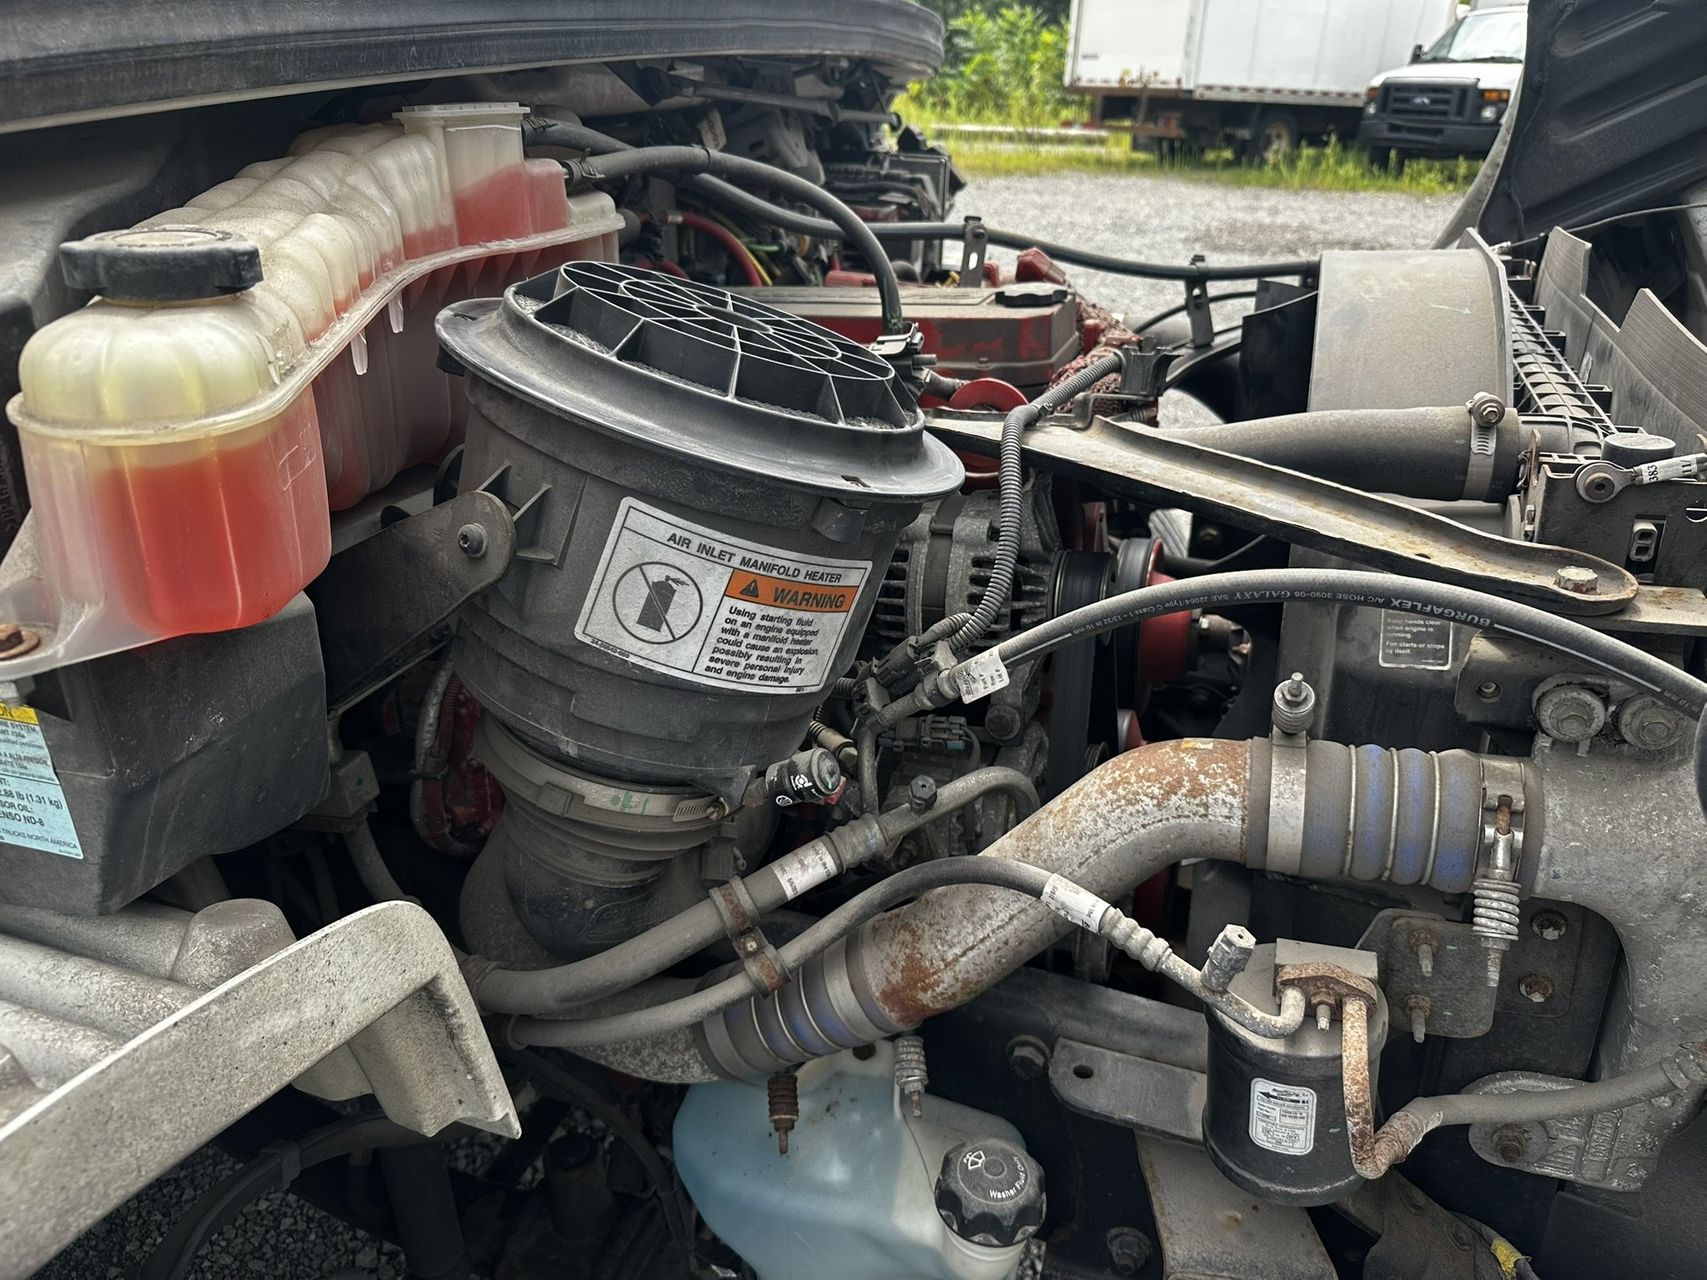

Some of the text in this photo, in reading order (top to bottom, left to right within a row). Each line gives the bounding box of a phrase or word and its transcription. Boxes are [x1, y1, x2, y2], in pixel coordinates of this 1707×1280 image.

[1647, 464, 1659, 482] 383
[666, 533, 842, 583] AIR INLET MANIFOLD HEATER
[773, 587, 846, 610] WARNING
[1164, 599, 1183, 610] Type
[1211, 593, 1229, 602] SAE
[1233, 590, 1290, 601] GALAXY
[1335, 592, 1364, 601] HOSE
[1367, 595, 1385, 604] A/C
[729, 606, 814, 626] Using starting fluid
[1134, 606, 1155, 616] Class
[1156, 604, 1163, 612] C
[1389, 597, 1491, 627] BURGAFLEX
[725, 617, 737, 625] on
[755, 624, 784, 634] engine
[786, 628, 819, 637] equipped
[1103, 613, 1122, 626] 13/32
[716, 636, 743, 648] could
[745, 643, 770, 652] cause
[721, 627, 740, 636] with
[752, 634, 789, 644] manifold
[790, 637, 813, 646] heater
[712, 646, 752, 661] possibly
[756, 654, 792, 665] resulting
[705, 665, 790, 684] and engine damage.
[708, 656, 805, 675] severe personal injury
[15, 790, 24, 800] lb
[26, 793, 46, 805] (1.31
[48, 796, 63, 810] kg)
[18, 804, 32, 813] OIL:
[0, 810, 22, 823] ENSO
[989, 1187, 1017, 1199] Washer
[1014, 1173, 1026, 1190] Fluid
